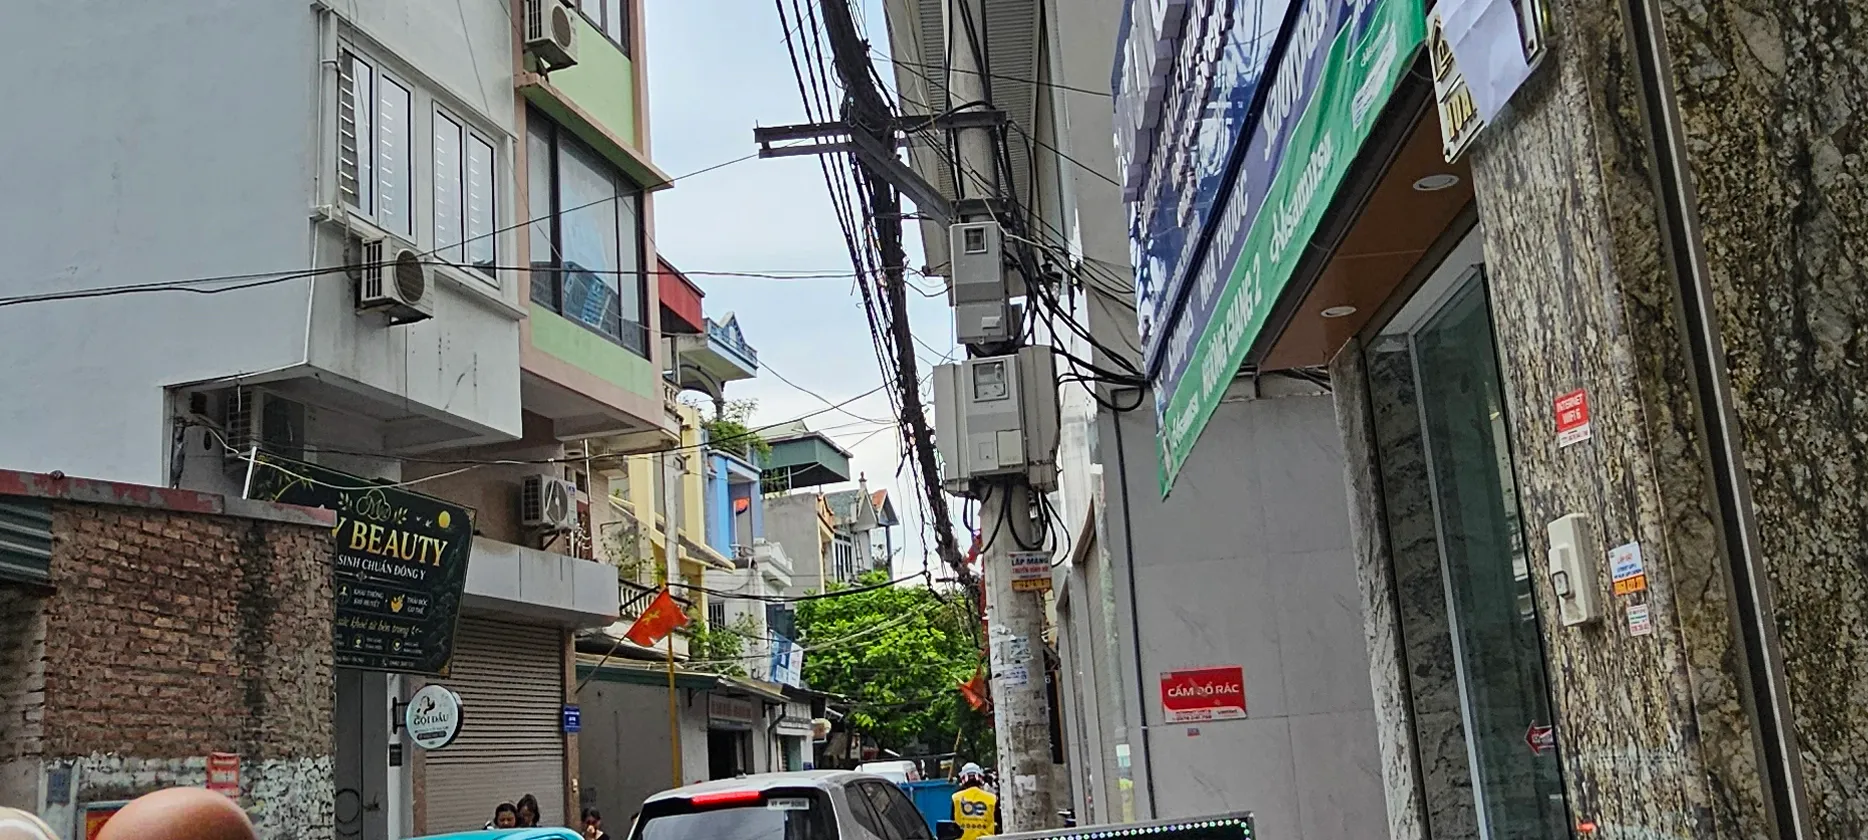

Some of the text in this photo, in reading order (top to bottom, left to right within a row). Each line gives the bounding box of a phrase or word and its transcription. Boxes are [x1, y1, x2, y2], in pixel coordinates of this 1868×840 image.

[1216, 168, 1248, 271] THUỐC
[1226, 270, 1254, 356] GIANG
[1253, 252, 1262, 307] 2
[349, 520, 449, 567] BEAUTY
[338, 554, 360, 568] SINH
[1167, 684, 1194, 697] CẤM
[1215, 682, 1240, 694] RÁC
[961, 796, 987, 816] be
